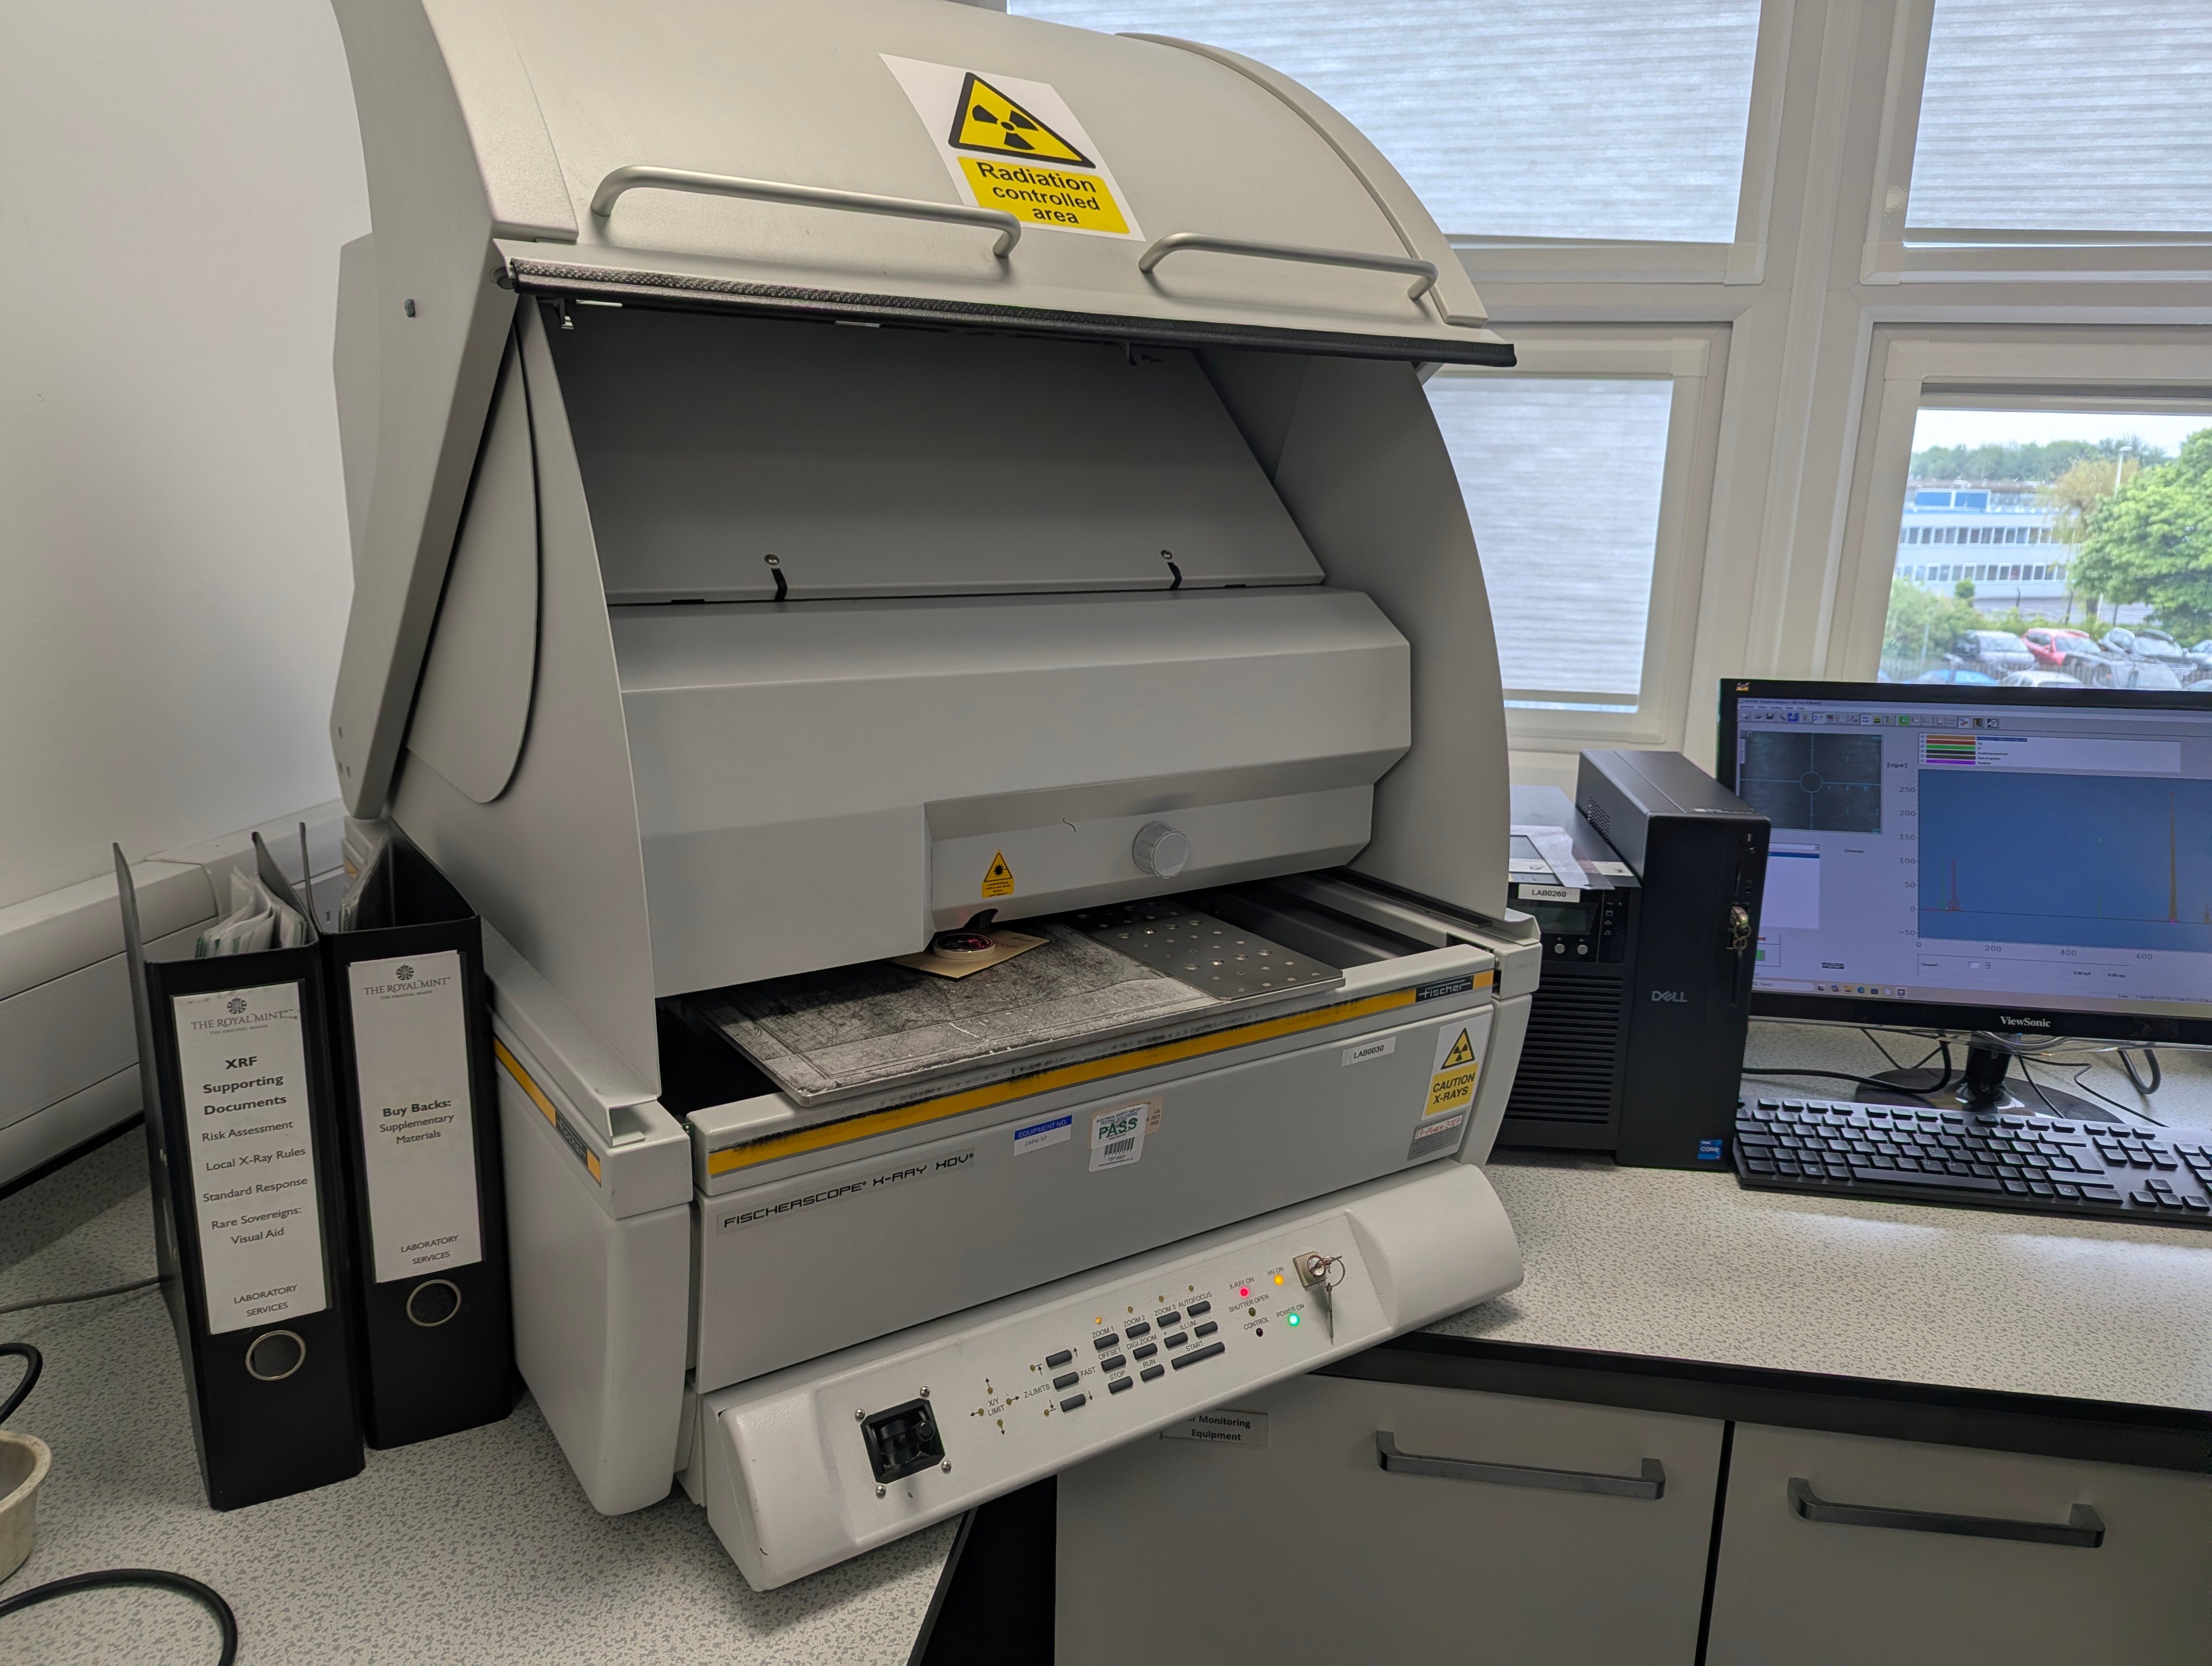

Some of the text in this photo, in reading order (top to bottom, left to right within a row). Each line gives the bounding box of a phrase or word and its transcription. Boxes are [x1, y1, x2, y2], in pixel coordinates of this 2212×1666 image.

[976, 162, 1097, 193] Radiation
[992, 184, 1101, 211] controlled
[1032, 206, 1079, 225] area
[1531, 889, 1566, 898] LAB0260
[364, 985, 385, 995] THE
[387, 982, 419, 993] ROYAL
[1651, 990, 1688, 1003] DELL
[191, 1020, 214, 1030] THE
[217, 1015, 252, 1028] ROYAL
[1999, 1015, 2050, 1027] ViewSonic
[1353, 1045, 1384, 1059] LAB0030
[225, 1056, 258, 1069] XRF
[203, 1076, 284, 1094] Supporting
[1433, 1073, 1475, 1092] CAUTION
[1433, 1086, 1469, 1105] X-RAYS
[204, 1097, 287, 1116] Documents
[383, 1100, 451, 1117] Buy Backs:
[380, 1114, 454, 1133] Supplementary
[1018, 1123, 1055, 1138] EQUIPMENT
[1098, 1117, 1138, 1139] PASS
[202, 1122, 294, 1142] Risk Assessment
[396, 1130, 441, 1144] Materials
[206, 1149, 306, 1171] Local X-Ray Rules
[872, 1165, 927, 1187] X-RAY
[203, 1178, 308, 1202] Standard Response
[212, 1207, 301, 1229] Rare Sovereigns:
[231, 1227, 285, 1244] Visual Aid
[401, 1235, 459, 1253] LABORATORY
[412, 1251, 450, 1265] SERVICES
[1229, 1280, 1244, 1290] X-RAY
[234, 1284, 298, 1304] LABORATORY
[1178, 1291, 1212, 1308] AUTOFOCUS
[246, 1302, 288, 1316] SERVICES
[1229, 1293, 1270, 1312] SHUTTER OPEN
[1154, 1306, 1172, 1316] ZOOM
[1276, 1306, 1296, 1318] POWER
[1123, 1317, 1141, 1327] ZOOM
[1179, 1320, 1198, 1330] ILLUM.
[1244, 1317, 1270, 1330] CONTROL
[1091, 1328, 1110, 1338] ZOOM
[1186, 1341, 1204, 1351] START
[1098, 1347, 1121, 1360] OFFSET
[1142, 1359, 1156, 1368] RUN
[1081, 1366, 1096, 1377] FAST
[1109, 1370, 1126, 1381] STOP
[1024, 1383, 1051, 1398] Z-LIMITS
[988, 1398, 999, 1407] X/Y
[988, 1405, 1005, 1417] LIMIT
[1199, 1415, 1251, 1428] Monitoring
[1191, 1429, 1241, 1441] Equipment
